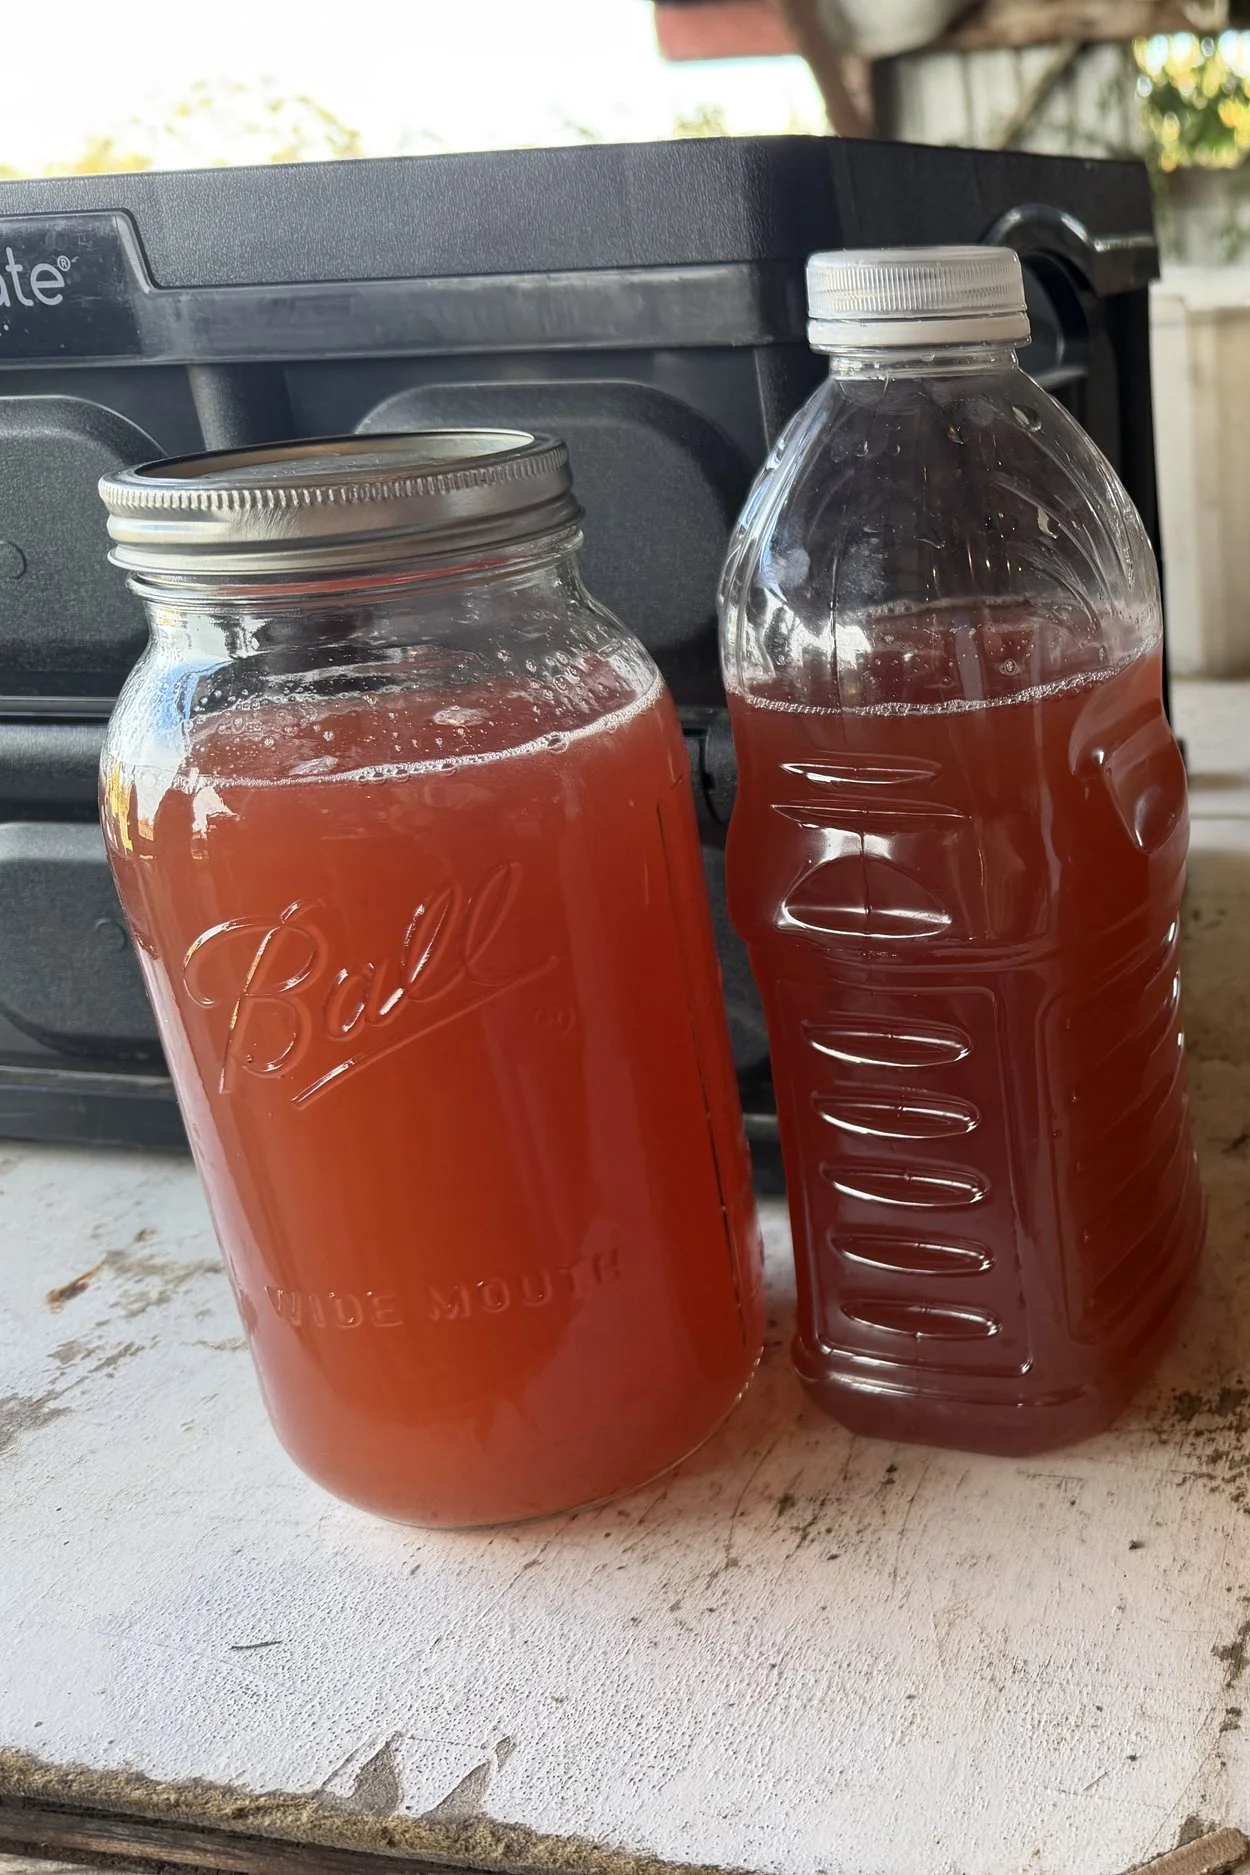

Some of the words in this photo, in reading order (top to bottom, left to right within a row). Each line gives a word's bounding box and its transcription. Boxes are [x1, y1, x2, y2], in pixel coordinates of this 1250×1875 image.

[183, 861, 548, 1096] Ball
[264, 1285, 404, 1329] WIDE
[430, 1247, 621, 1322] MOUTH
